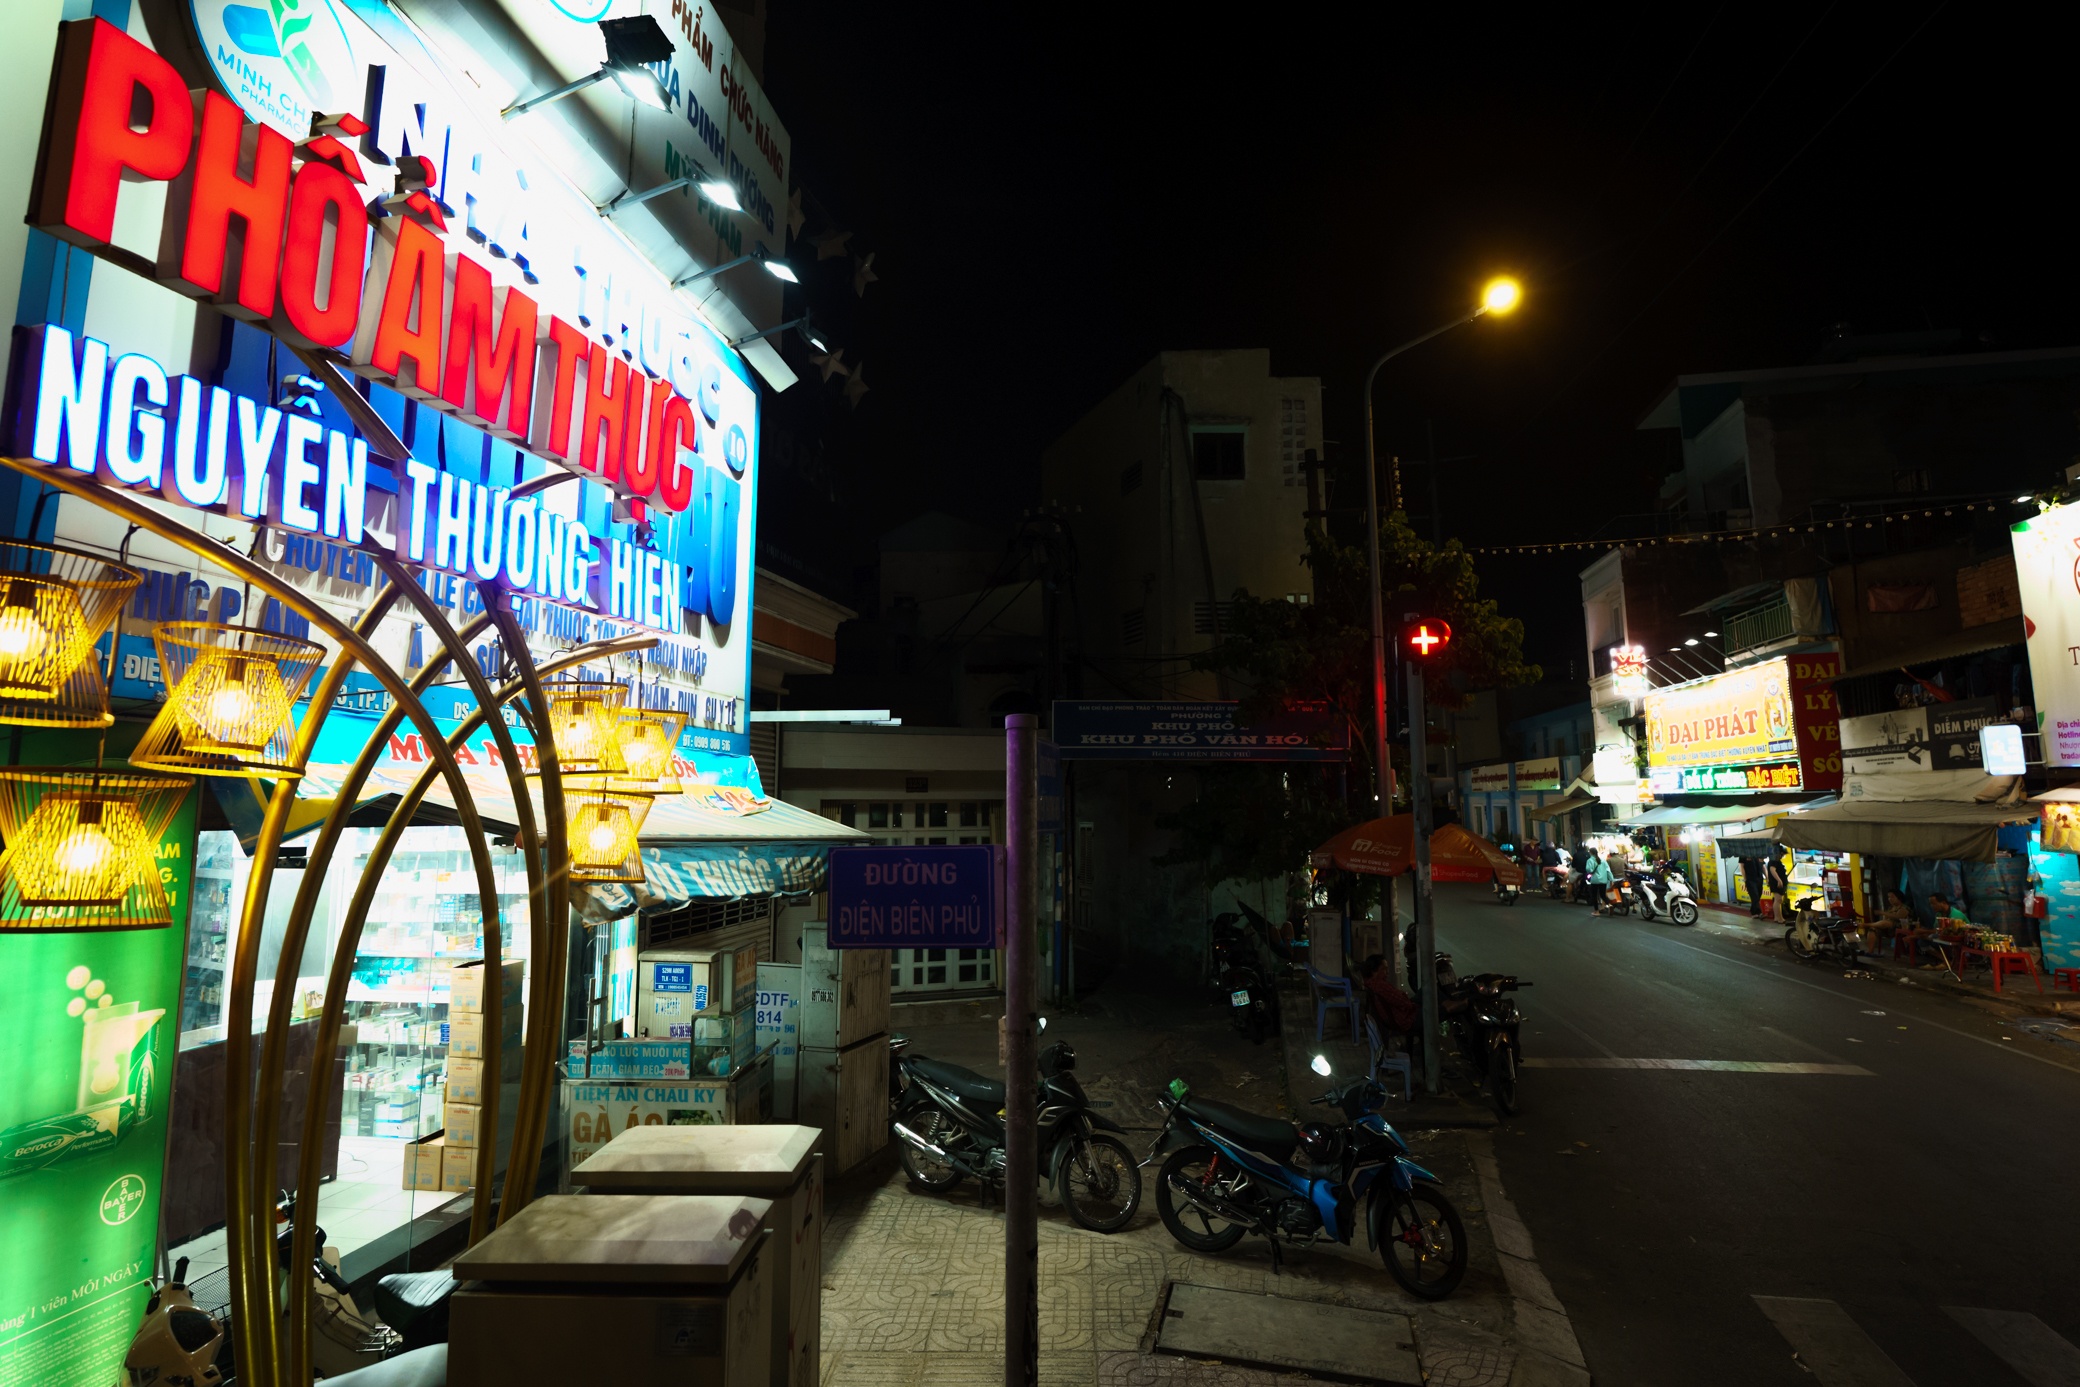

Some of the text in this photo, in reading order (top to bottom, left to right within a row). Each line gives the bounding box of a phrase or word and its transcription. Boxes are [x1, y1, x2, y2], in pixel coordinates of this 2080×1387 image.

[218, 44, 271, 97] MINH
[687, 89, 726, 167] DINH
[32, 322, 369, 546] NGUYỄN
[405, 458, 591, 612] THƯỢNG
[1795, 662, 1836, 684] ĐẠI
[1804, 690, 1833, 711] LÝ
[1151, 722, 1192, 731] KHU
[1668, 706, 1758, 749] ĐẠI PHÁT
[1808, 720, 1839, 741] VÉ
[2056, 720, 2069, 731] Địa
[1080, 734, 1137, 744] KHU
[1142, 731, 1197, 745] PHỐ
[1203, 732, 1259, 745] VĂN
[1813, 750, 1841, 774] SỐ
[1370, 846, 1401, 857] Food
[681, 846, 776, 899] THUỐC
[775, 855, 826, 892] THEO
[864, 857, 958, 886] ĐƯỜNG
[839, 894, 981, 942] ĐIỆN BIÊN PHỦ
[757, 1010, 782, 1024] 814
[137, 1065, 150, 1117] Berocca
[14, 1135, 64, 1157] Berocca
[103, 1189, 143, 1211] BAYER
[41, 1295, 69, 1314] viên
